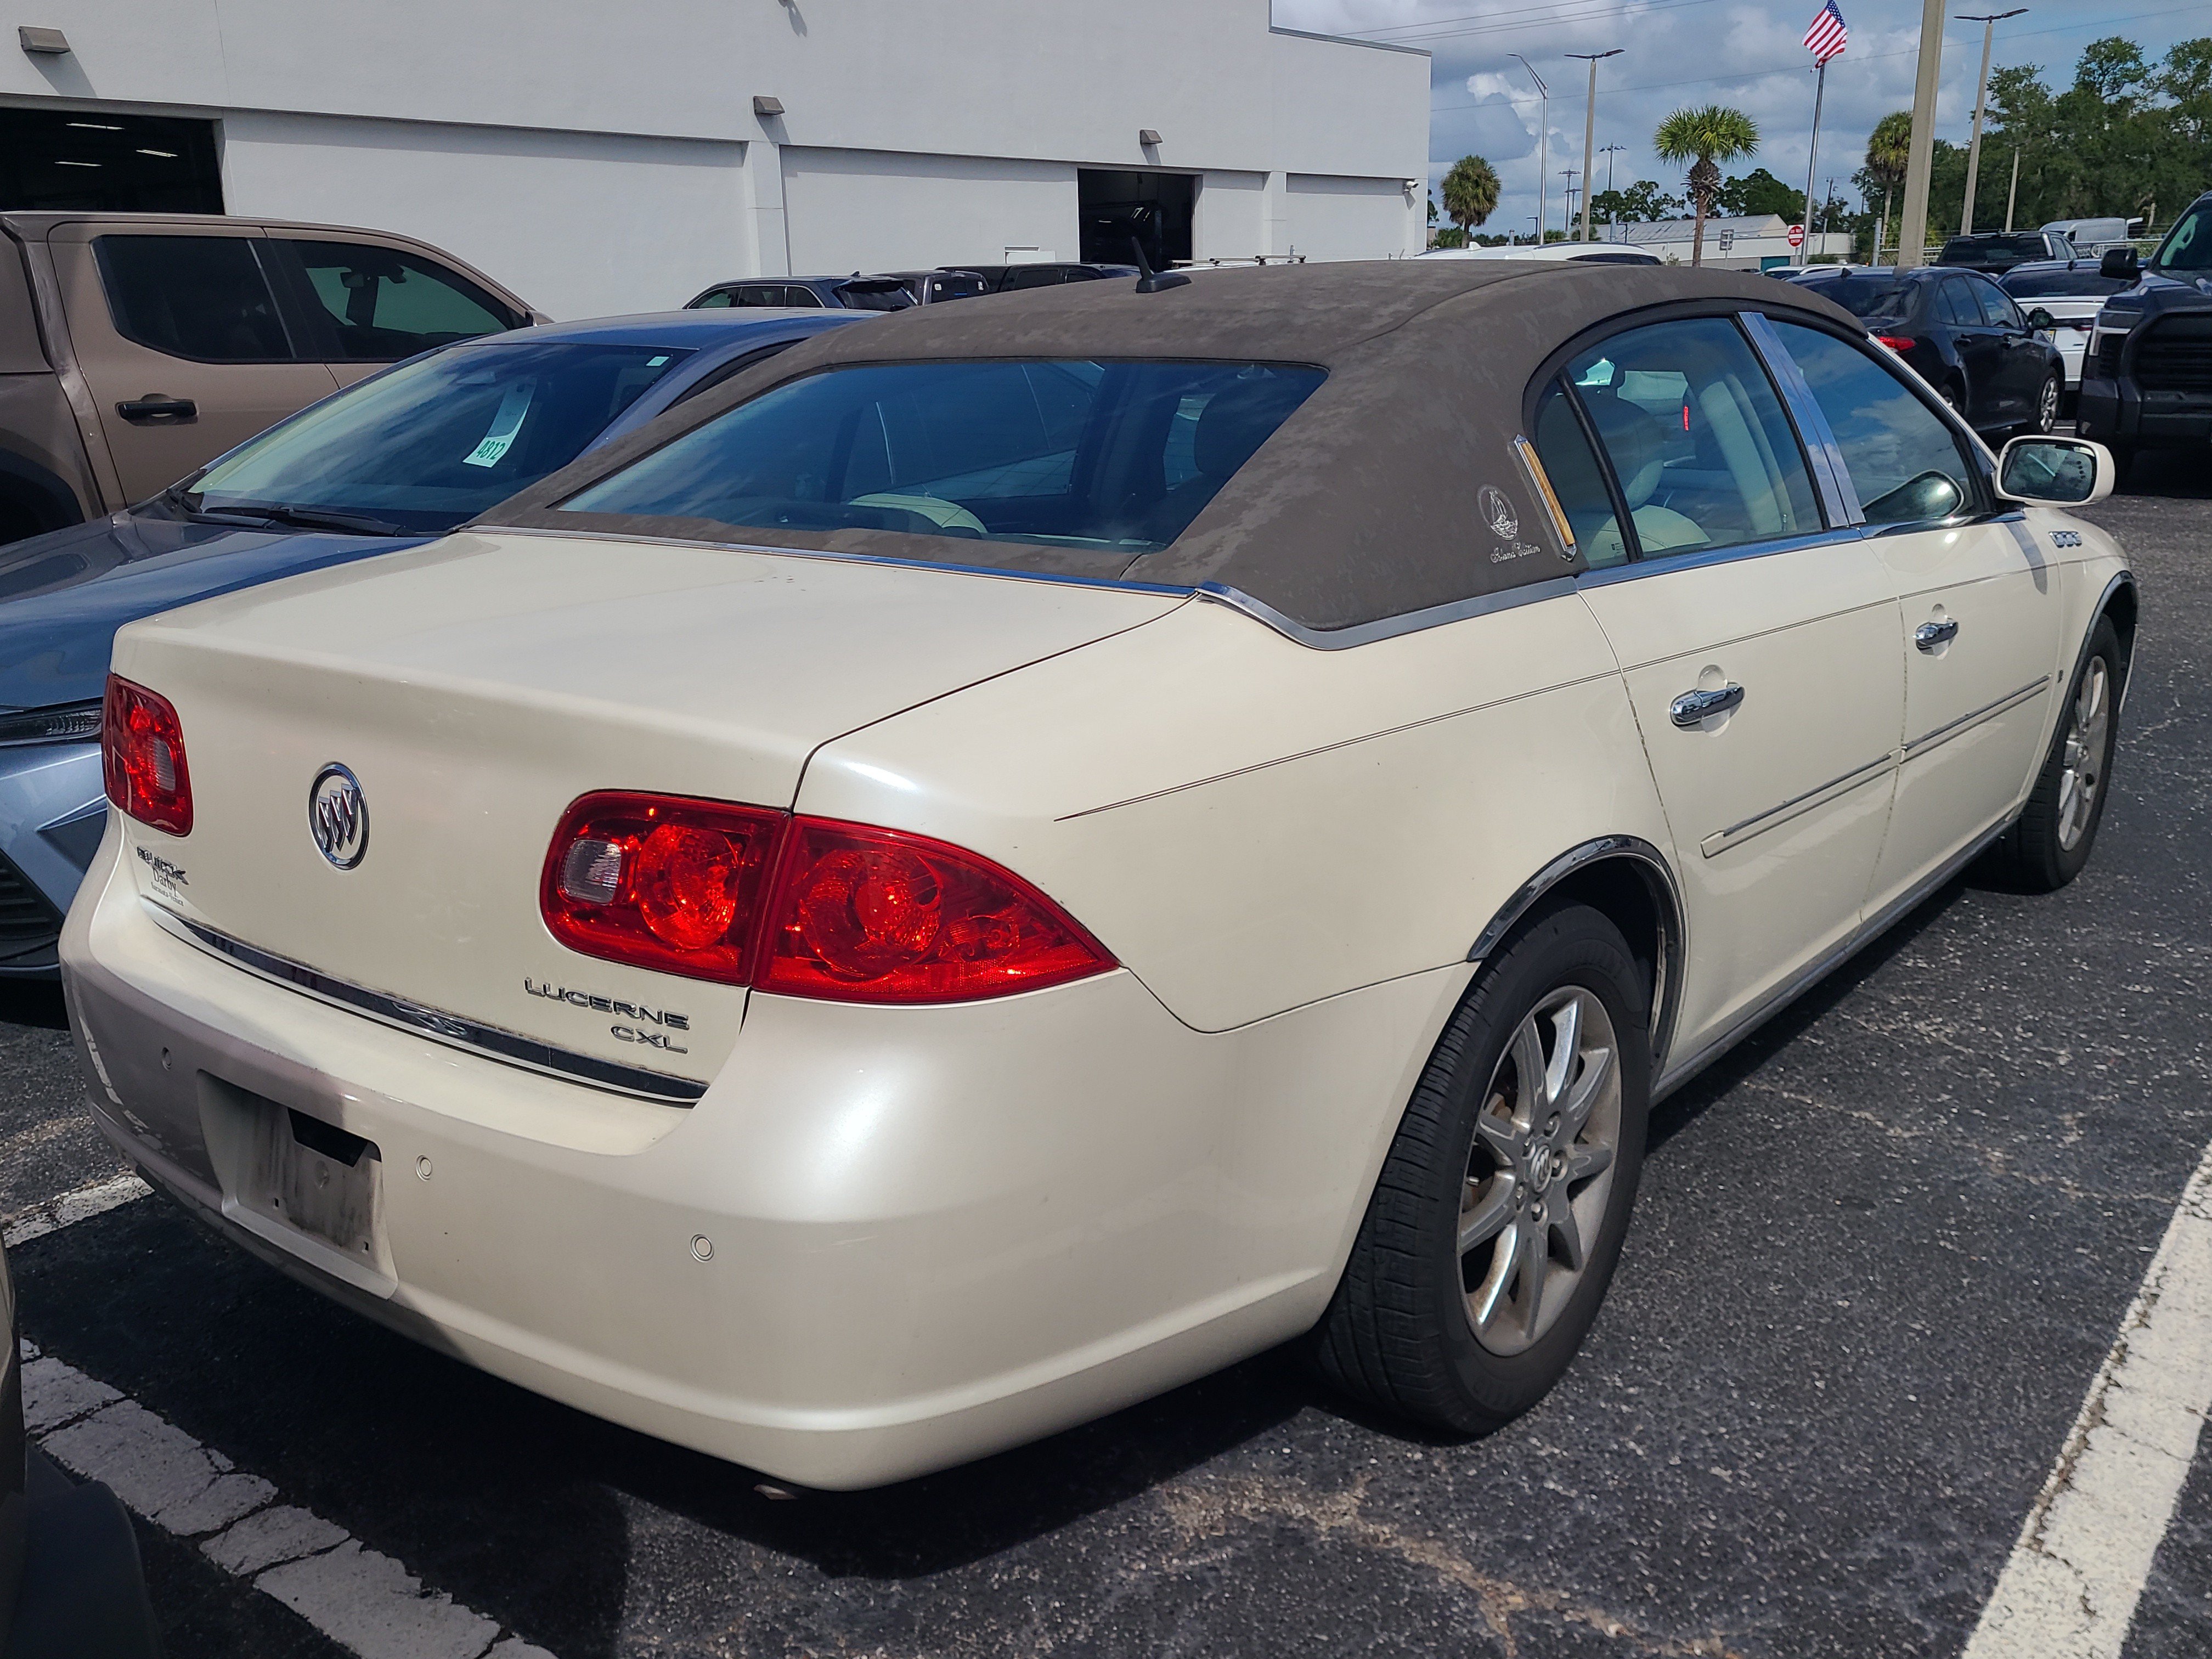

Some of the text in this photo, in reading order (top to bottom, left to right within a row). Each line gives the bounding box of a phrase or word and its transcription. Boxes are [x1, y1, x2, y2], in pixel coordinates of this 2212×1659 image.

[476, 440, 506, 460] 4812
[137, 846, 189, 885] BUICK
[153, 867, 178, 898] Darby
[524, 977, 690, 1030] LUCERNE
[610, 1024, 689, 1054] CXL
